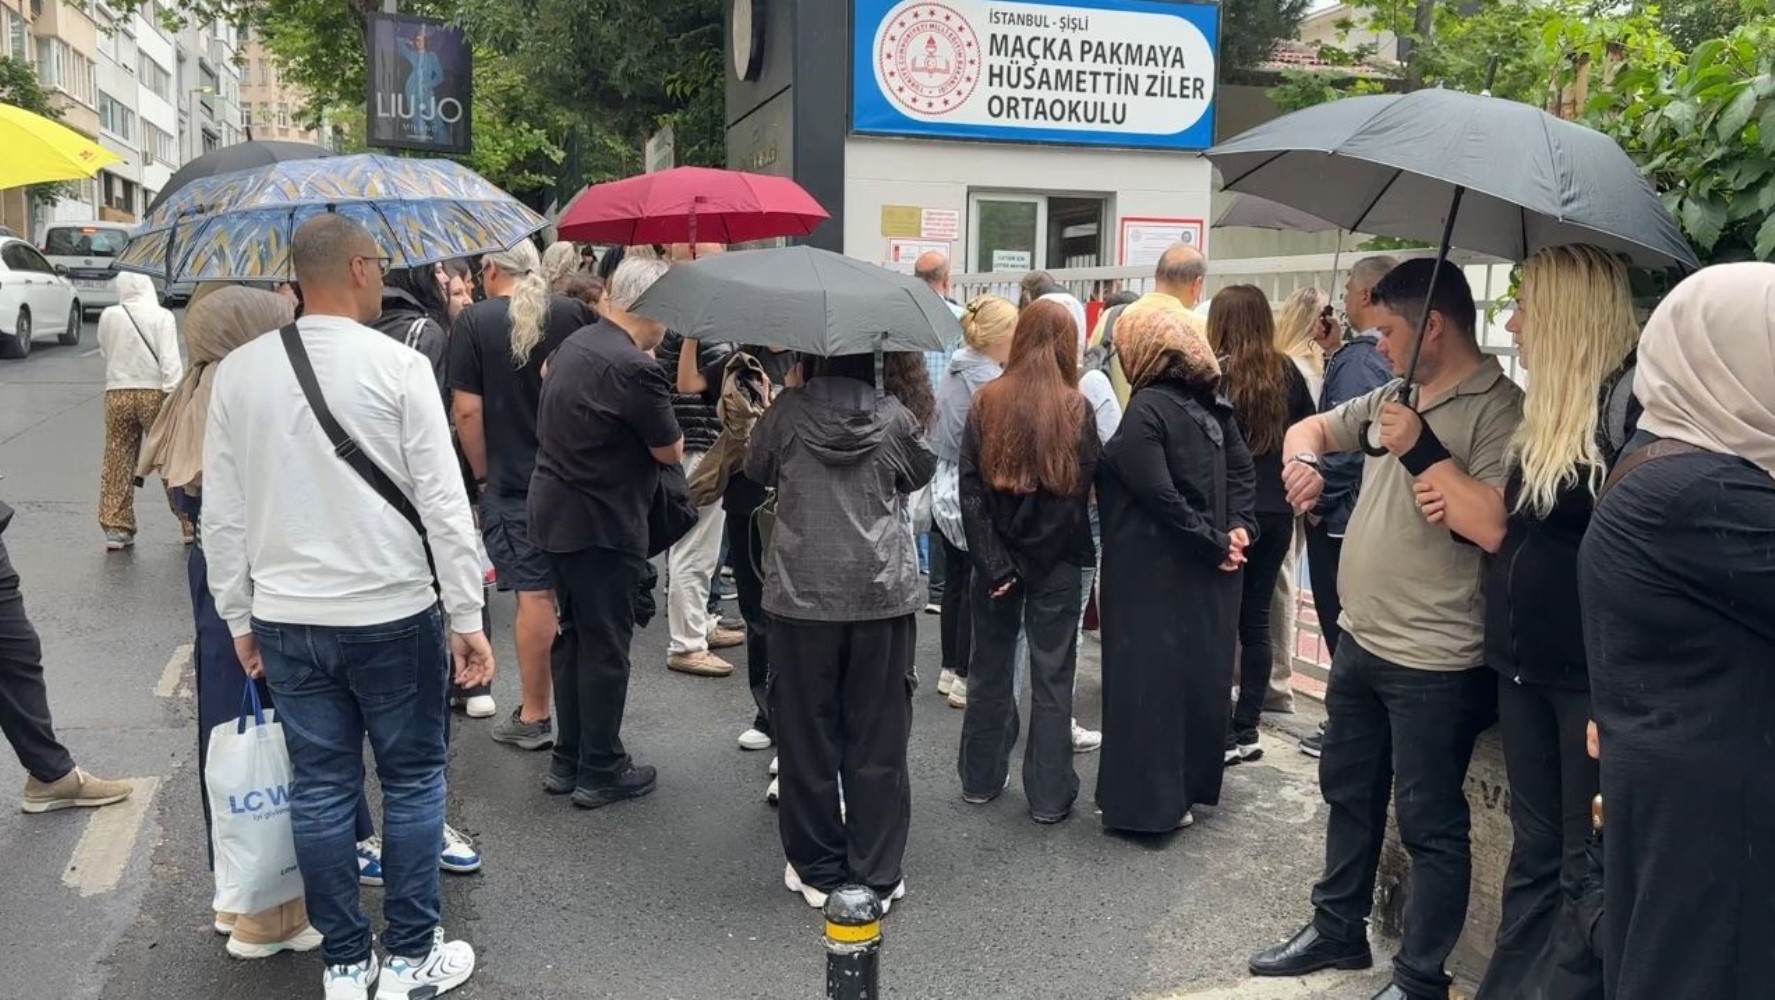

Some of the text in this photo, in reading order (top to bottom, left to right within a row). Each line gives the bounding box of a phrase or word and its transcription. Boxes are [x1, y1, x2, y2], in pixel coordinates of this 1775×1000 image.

[989, 8, 1050, 28] İSTANBUL
[1059, 14, 1089, 33] ŞİŞLİ
[988, 33, 1186, 69] MAÇKA PAKMAYA
[988, 60, 1205, 100] HÜSAMETTİN ZİLER
[987, 95, 1127, 124] ORTAOKULU
